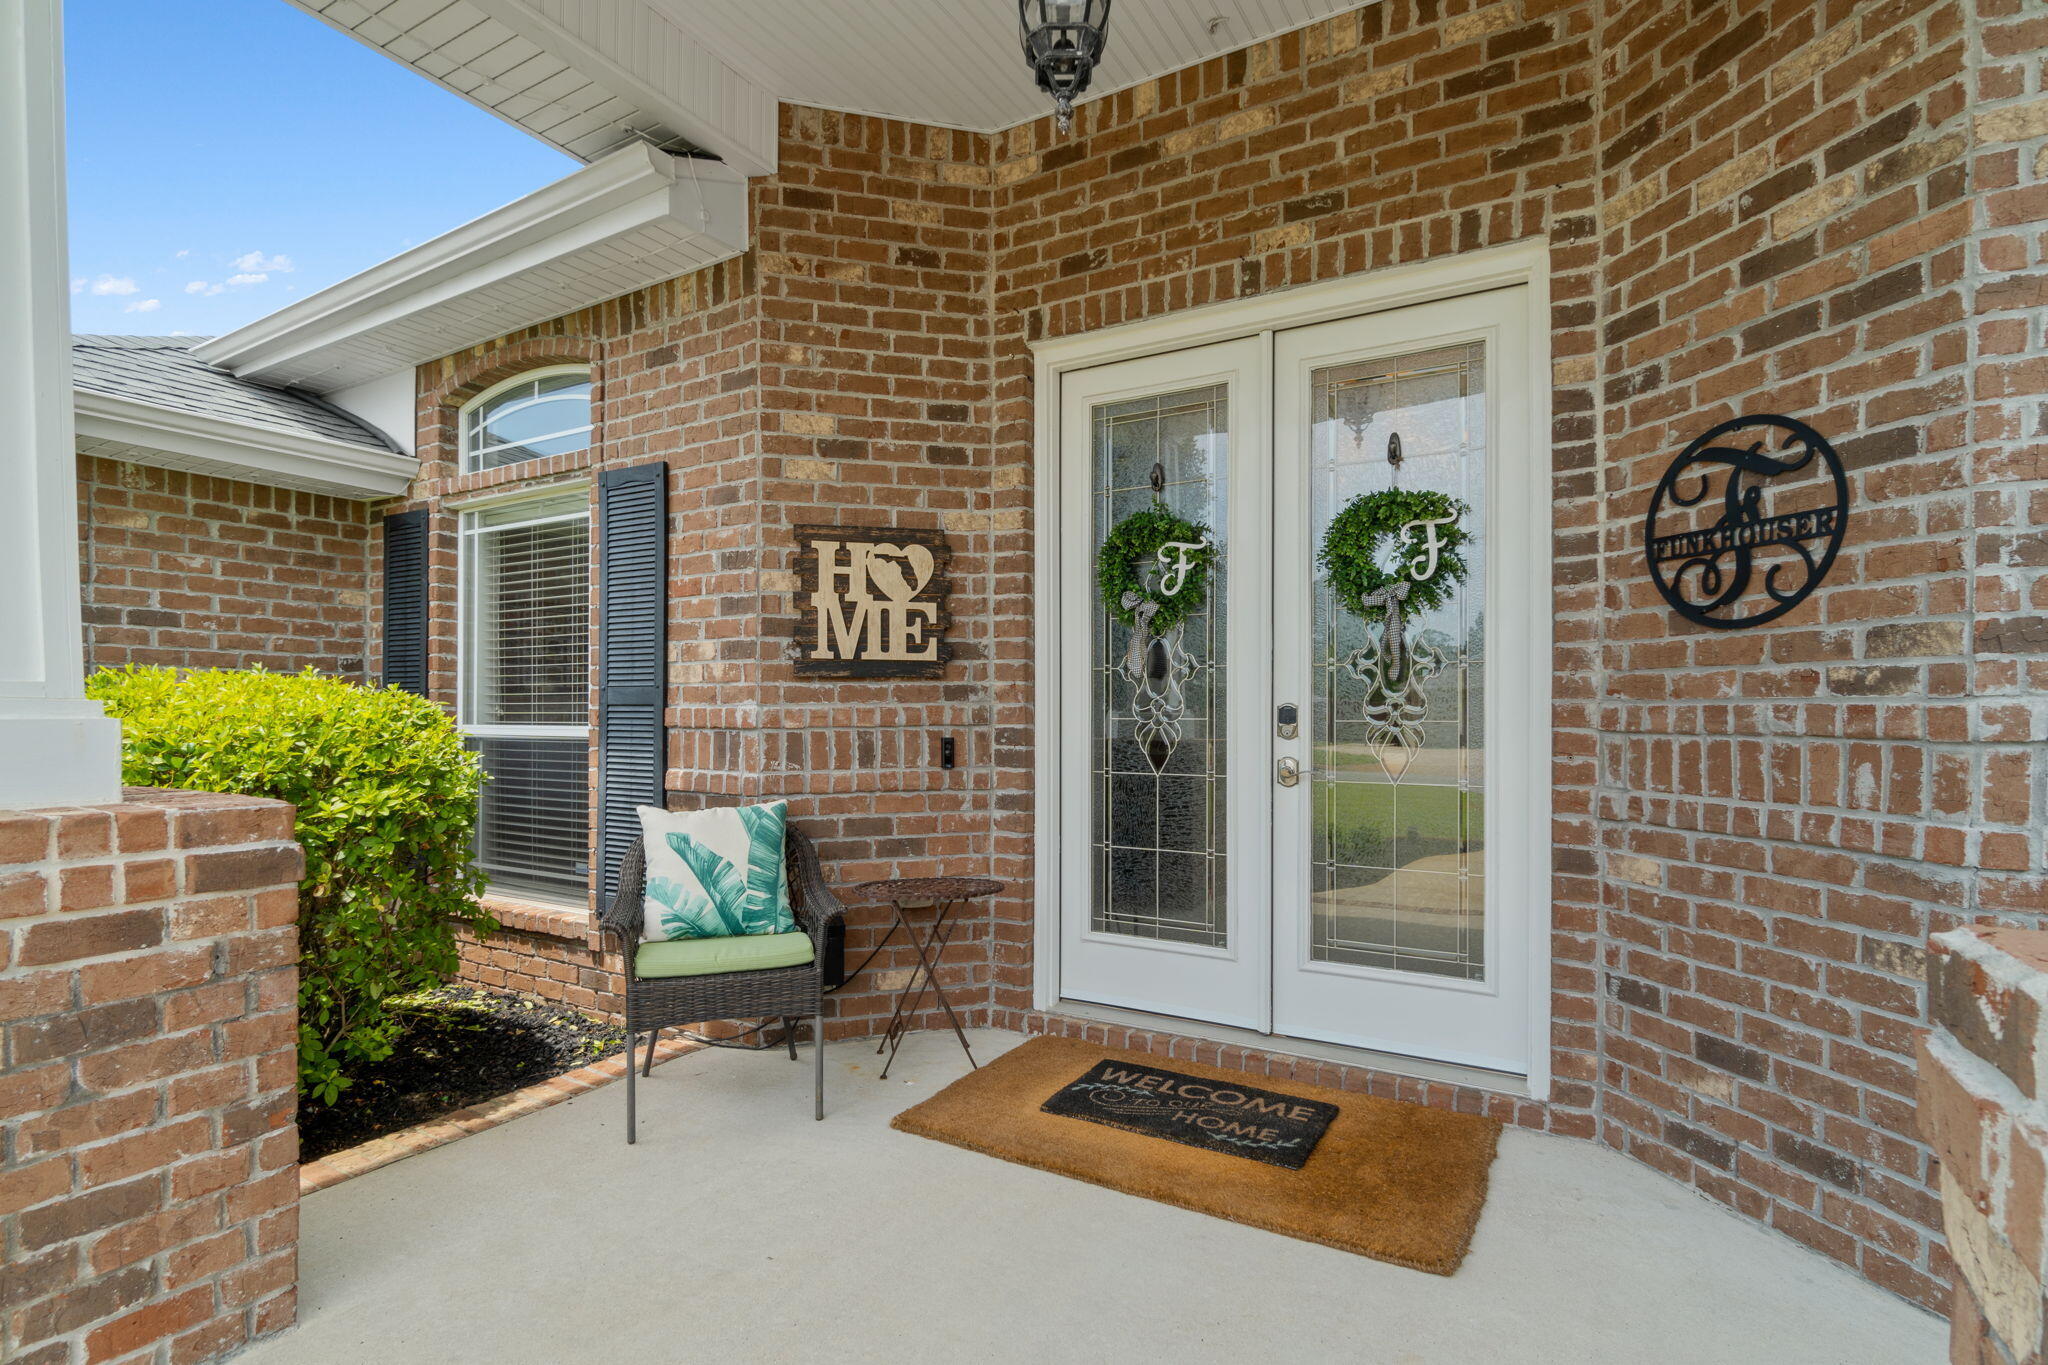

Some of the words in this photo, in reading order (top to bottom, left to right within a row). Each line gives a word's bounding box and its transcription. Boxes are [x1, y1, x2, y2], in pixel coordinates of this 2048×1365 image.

[1400, 507, 1458, 581] F
[1652, 510, 1834, 560] FUNKHOUSER
[1157, 536, 1207, 596] F
[1101, 1066, 1315, 1123] WELCOME
[1171, 1110, 1281, 1142] HOME
